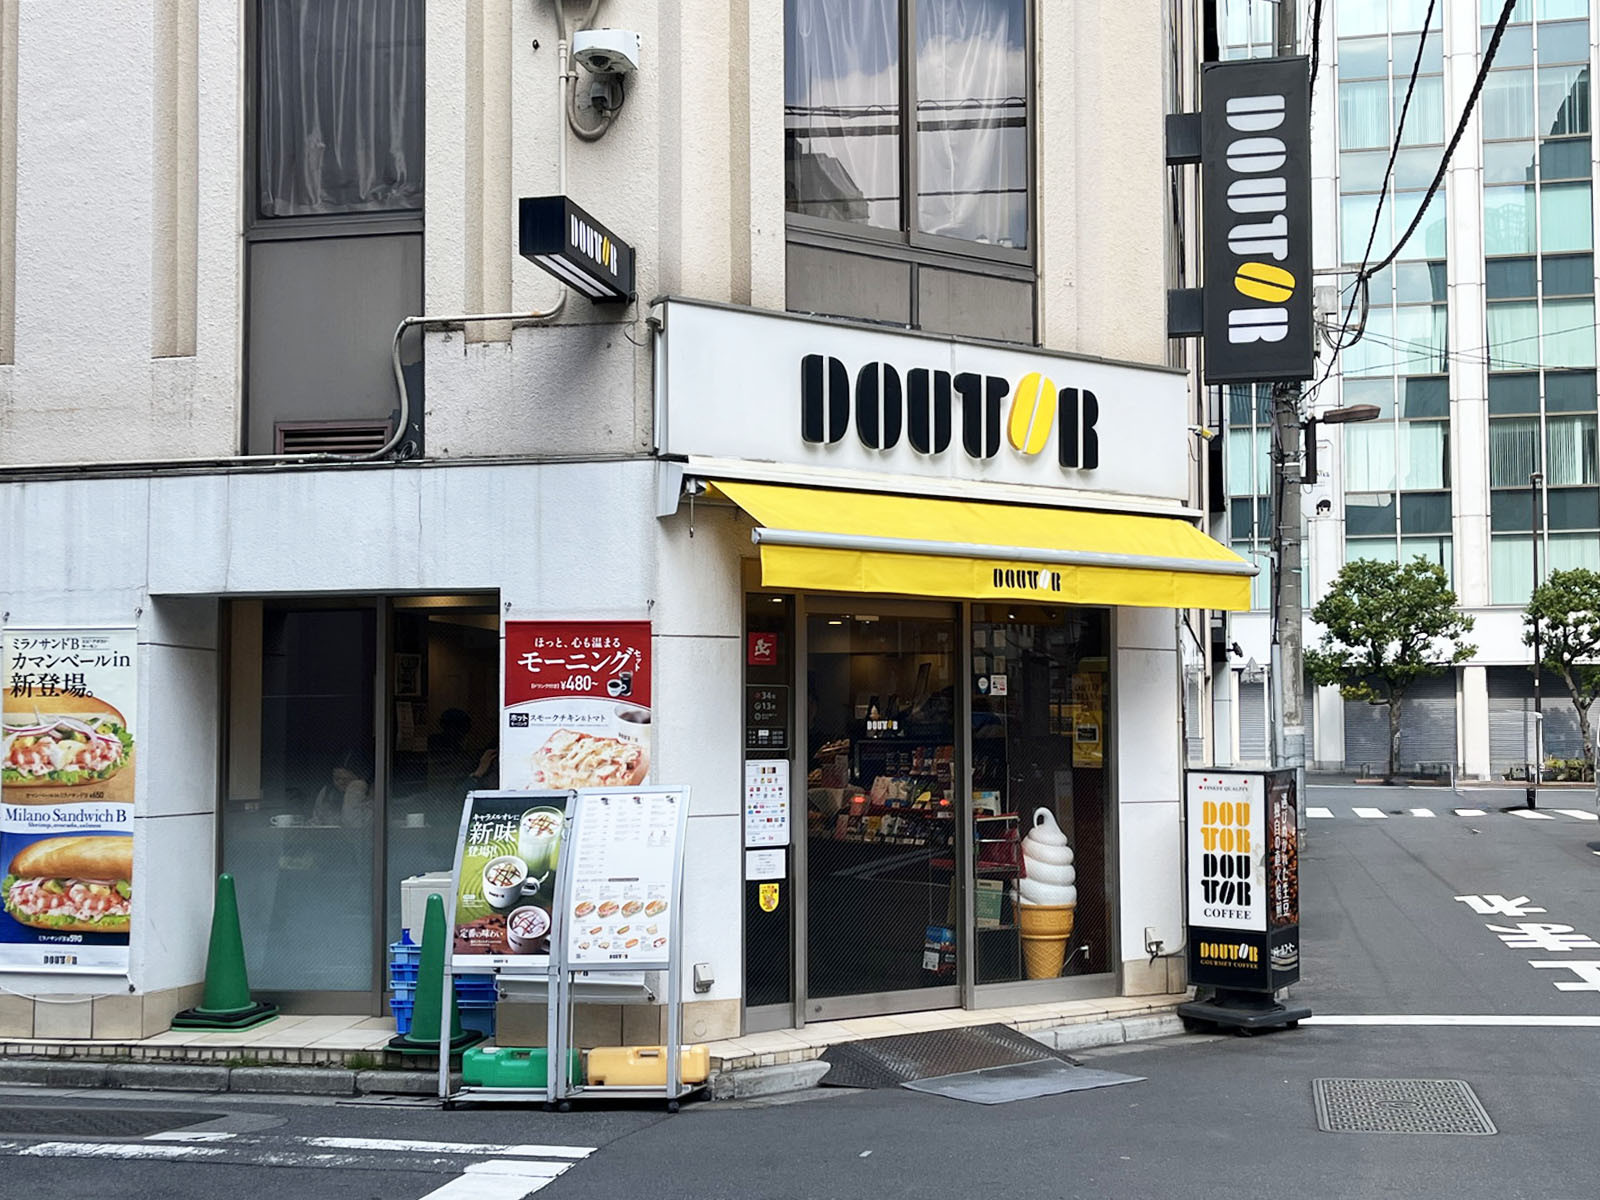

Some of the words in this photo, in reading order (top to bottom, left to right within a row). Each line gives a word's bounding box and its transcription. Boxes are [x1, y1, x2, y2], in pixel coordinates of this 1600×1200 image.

[1226, 94, 1296, 344] DOUTOR
[570, 213, 618, 277] DOUTOR
[801, 354, 1099, 470] DOUTOR
[993, 567, 1062, 592] DOUTOR
[12, 637, 80, 651] ミラノサンドB
[534, 637, 621, 649] ほっと、心も温まる
[11, 650, 131, 670] カマンベールin
[517, 646, 635, 675] モーニング
[10, 672, 94, 698] 新登場。
[866, 719, 899, 731] DOUTOR
[5, 808, 51, 822] Milano
[52, 809, 113, 822] Sandwich
[116, 809, 127, 822] B
[1202, 801, 1251, 826] DOU
[469, 821, 517, 845] 新味
[1200, 827, 1251, 853] TOR
[1203, 853, 1251, 880] DOU
[1201, 880, 1252, 906] TOR
[1203, 908, 1252, 920] COFFEE
[1200, 942, 1258, 962] DOUTOR
[1233, 962, 1258, 970] COFFEE
